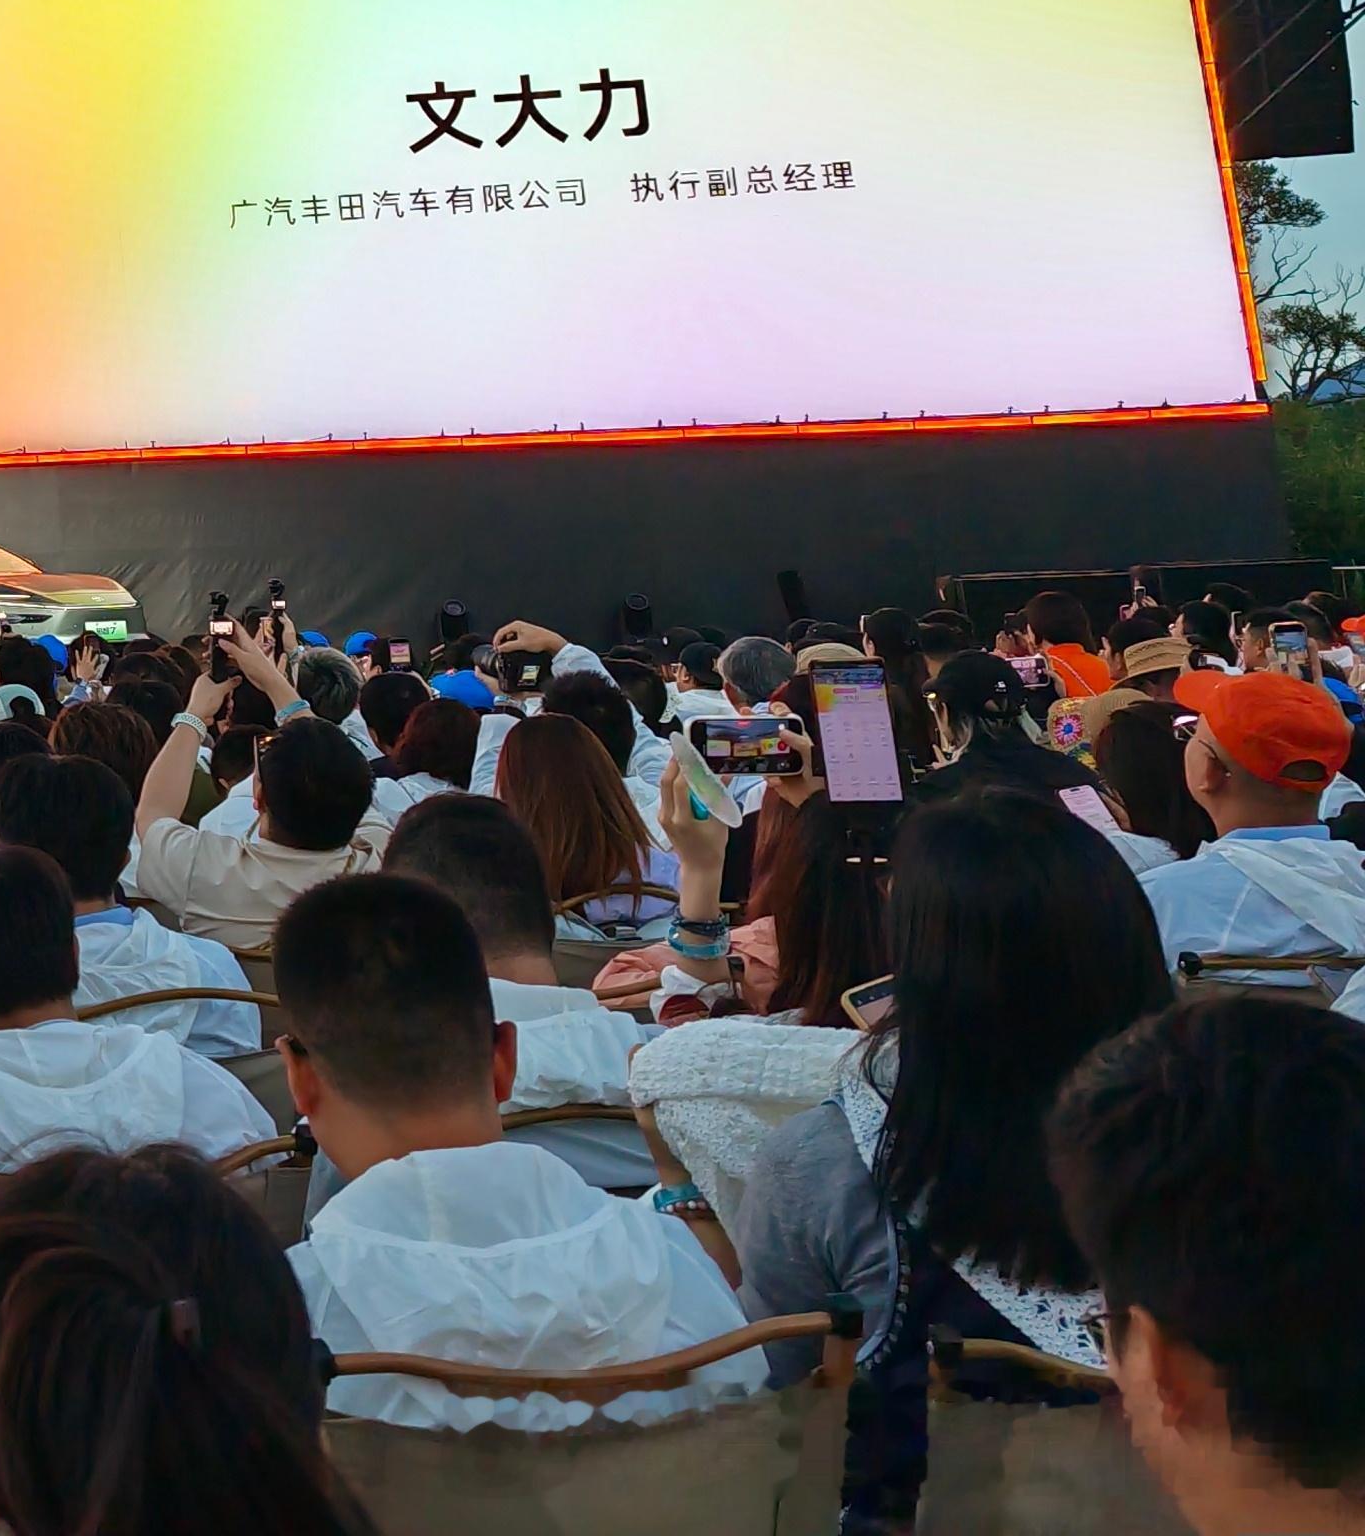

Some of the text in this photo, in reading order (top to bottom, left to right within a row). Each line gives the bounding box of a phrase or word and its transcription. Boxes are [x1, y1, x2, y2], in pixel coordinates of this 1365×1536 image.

[405, 68, 650, 154] 文大力
[228, 160, 857, 230] 广汽丰田汽车有限公司 执行副总经理
